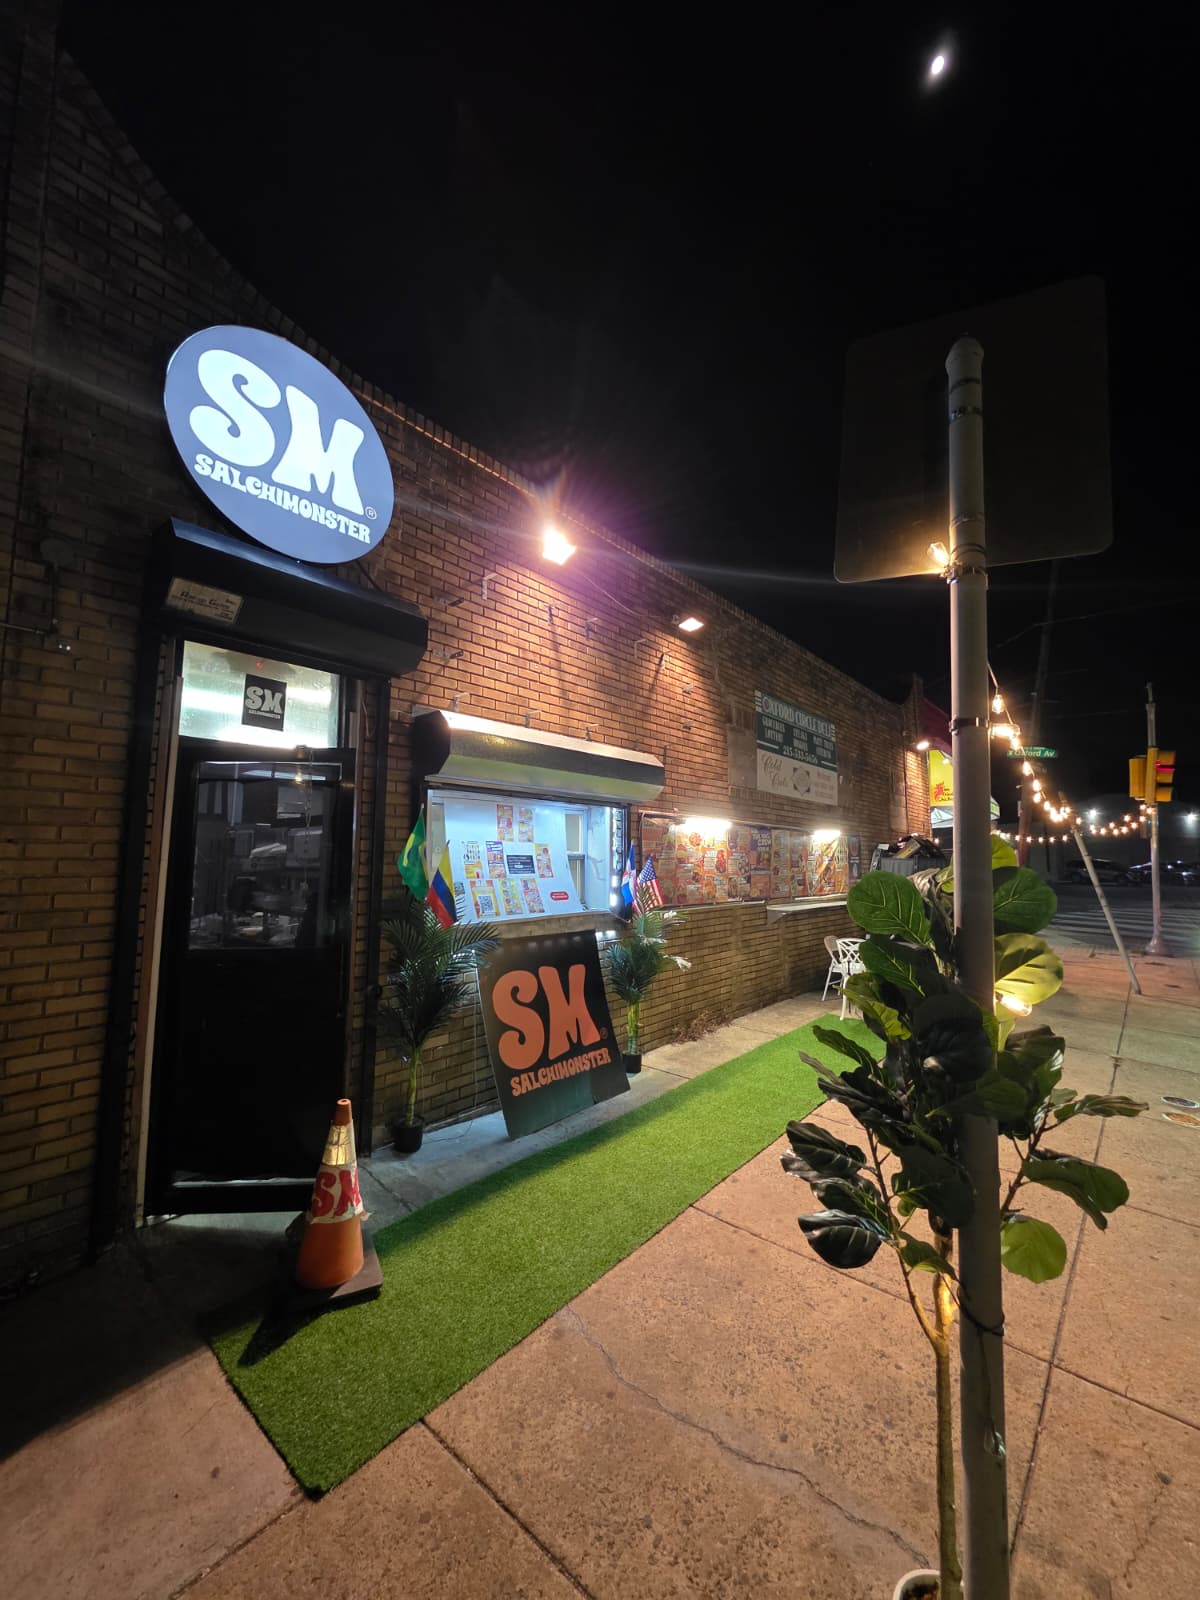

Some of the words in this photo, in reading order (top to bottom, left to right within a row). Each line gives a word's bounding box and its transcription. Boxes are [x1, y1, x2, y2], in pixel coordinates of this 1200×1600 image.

[189, 348, 365, 516] SM
[194, 453, 371, 544] SALCHIMONSTER
[244, 685, 284, 715] SM
[492, 963, 601, 1070] SM
[510, 1047, 612, 1097] SALCHIMONSTER
